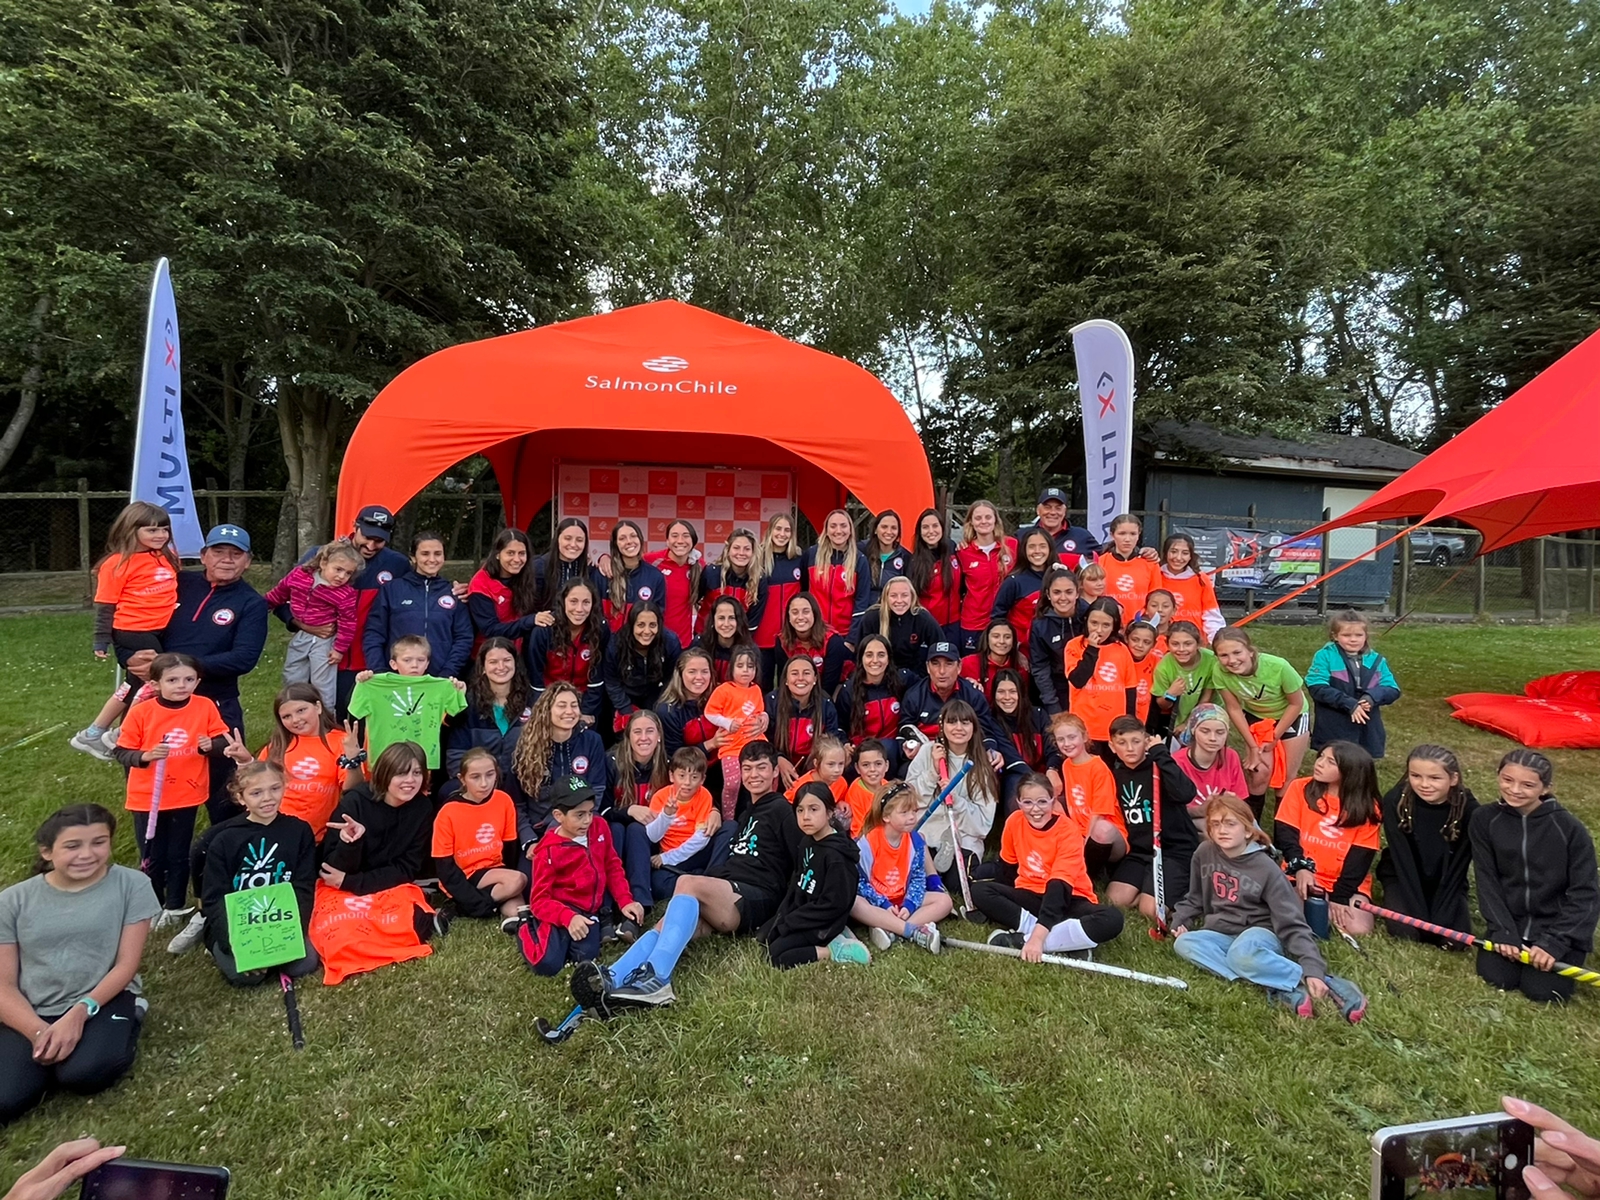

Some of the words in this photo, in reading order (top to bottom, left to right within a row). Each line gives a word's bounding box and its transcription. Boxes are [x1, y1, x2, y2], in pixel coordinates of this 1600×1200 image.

[585, 375, 738, 395] SalmonChile
[1212, 868, 1240, 902] 62
[248, 908, 294, 925] kids
